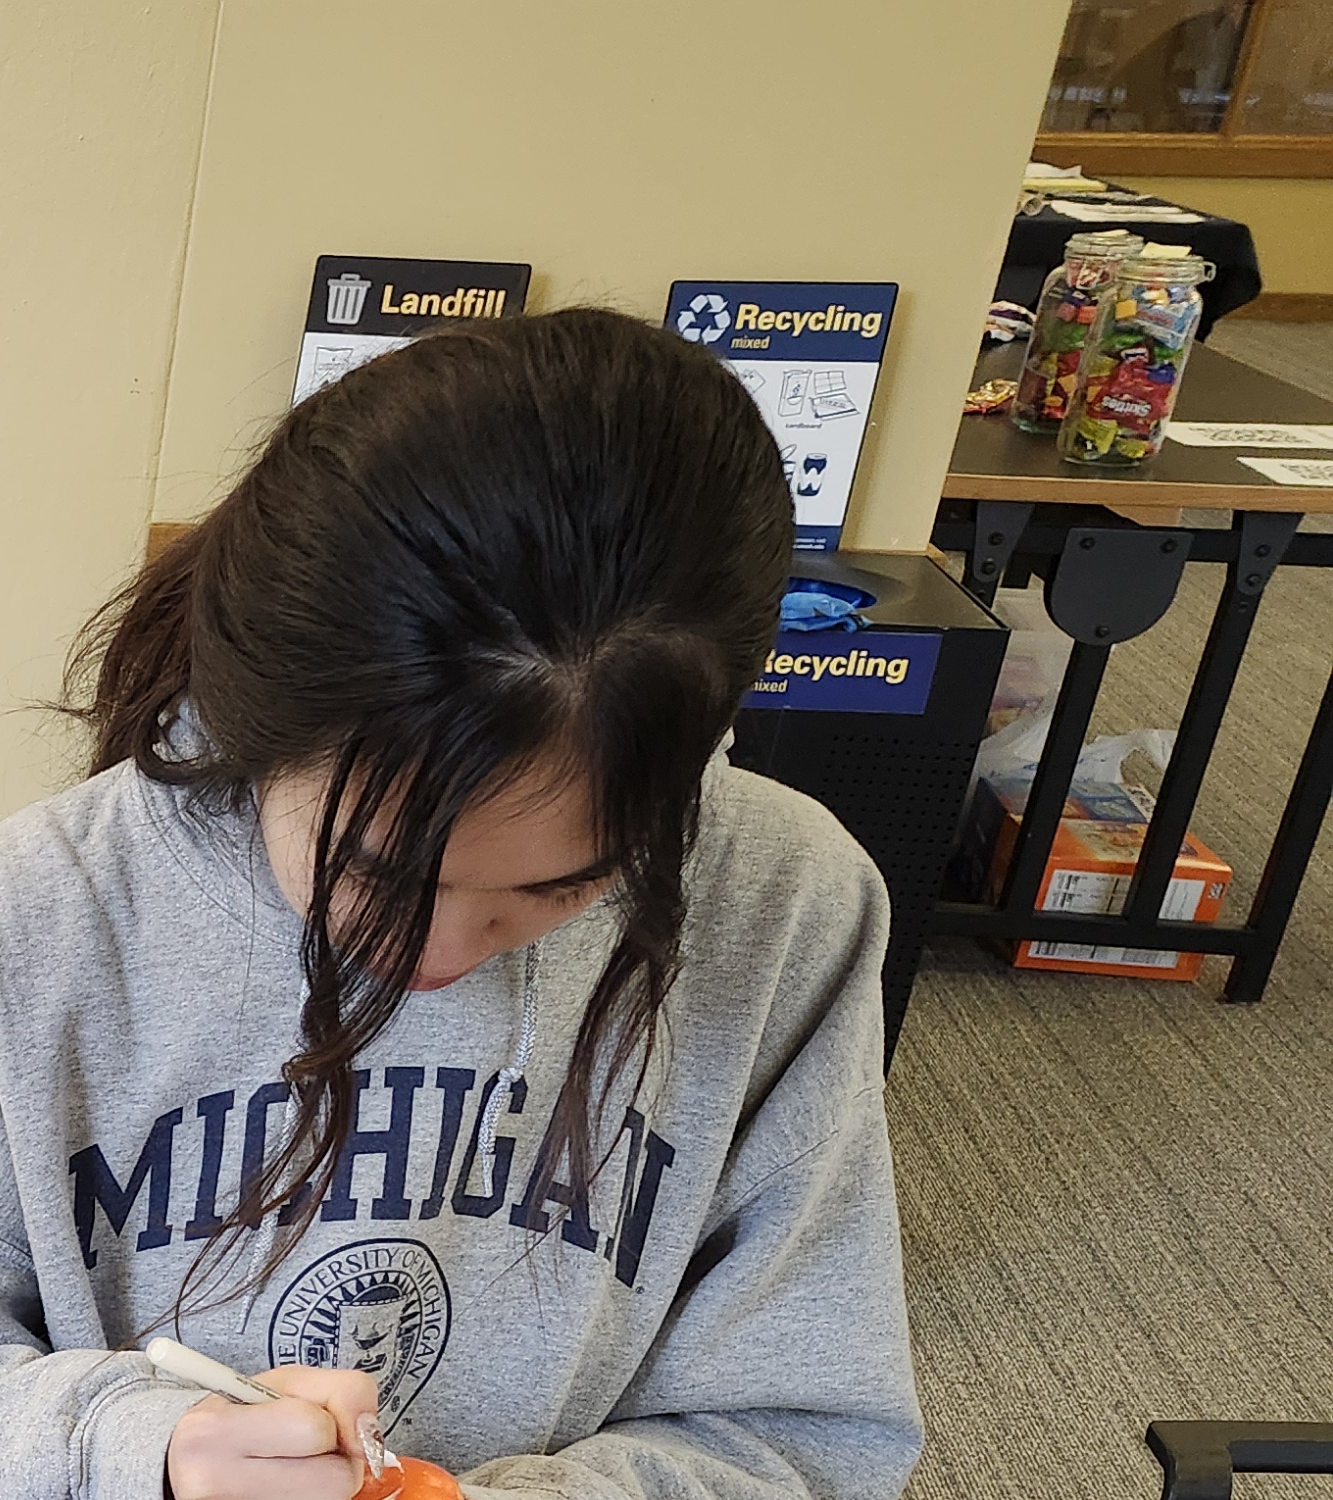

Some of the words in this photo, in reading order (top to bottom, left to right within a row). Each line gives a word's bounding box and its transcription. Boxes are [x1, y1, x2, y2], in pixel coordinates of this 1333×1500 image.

[381, 284, 506, 318] Landfill
[735, 304, 882, 338] Recycling
[731, 336, 770, 349] mixed
[69, 1066, 676, 1289] MICHIGAN
[402, 1249, 422, 1269] OF
[279, 1247, 400, 1337] UNIVERSITY
[405, 1260, 443, 1379] MICHIGAN
